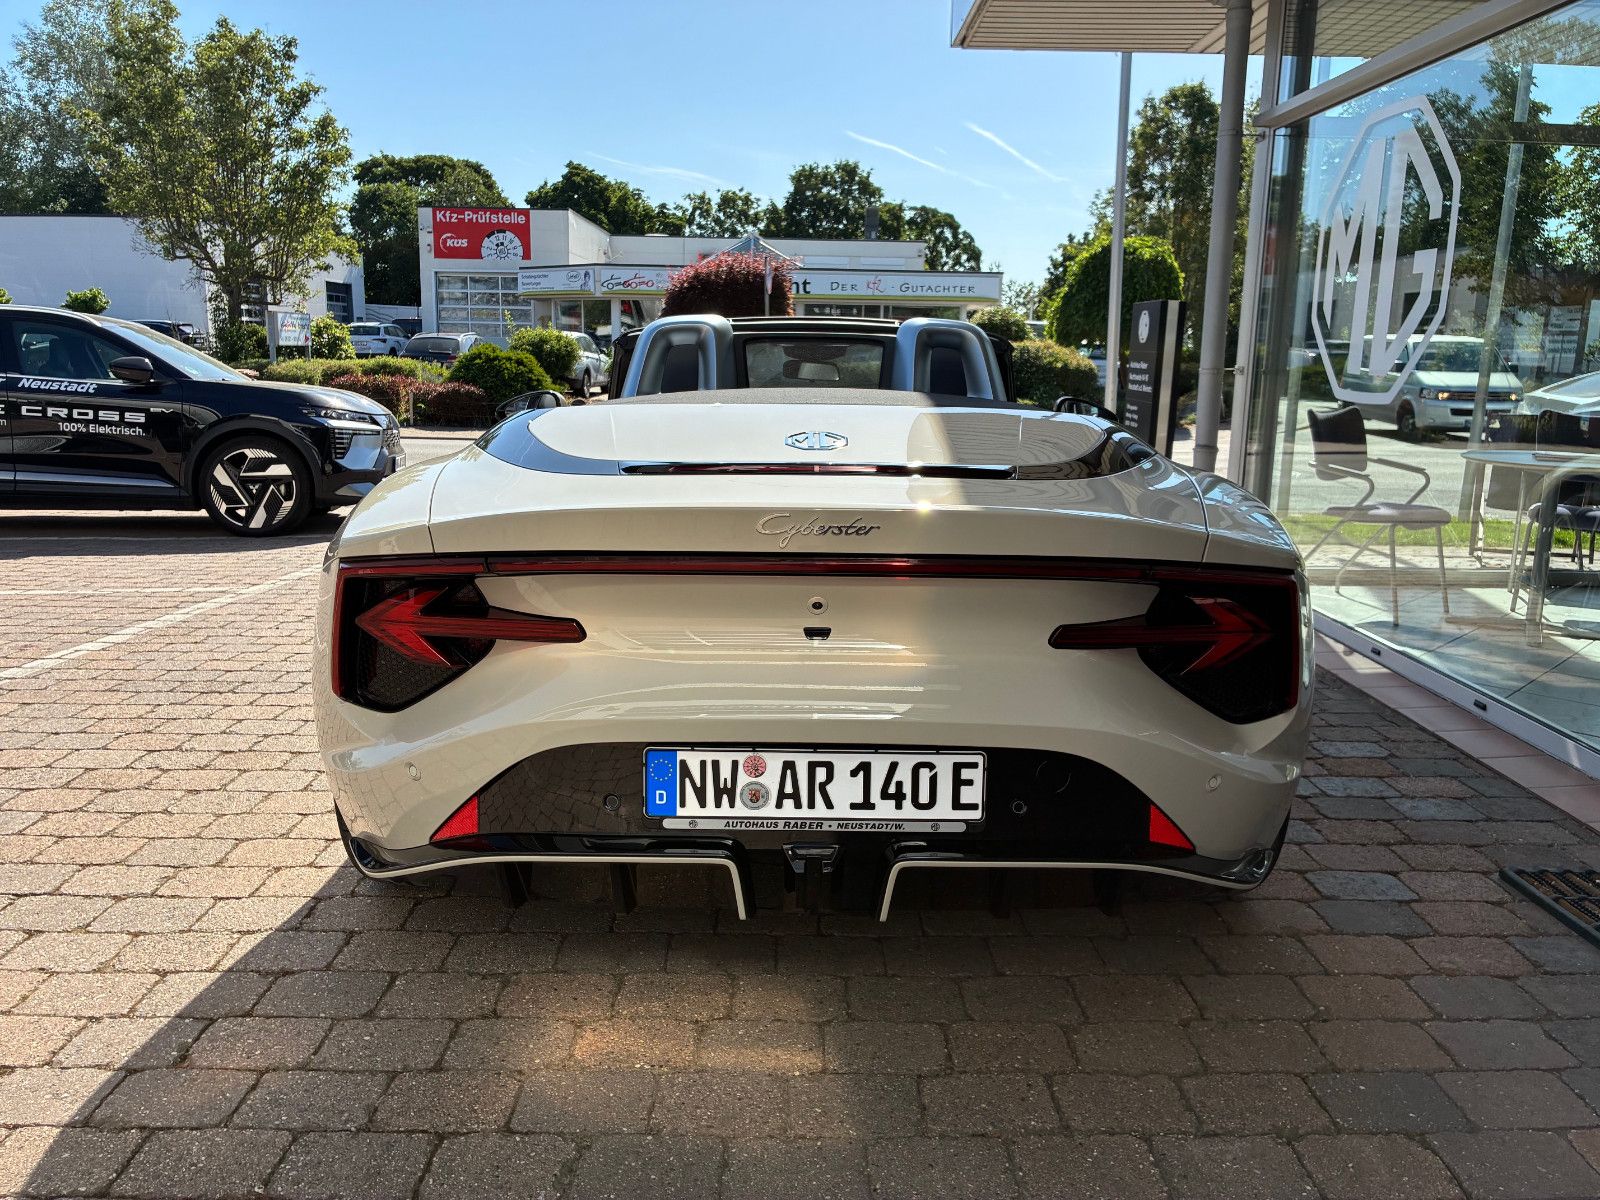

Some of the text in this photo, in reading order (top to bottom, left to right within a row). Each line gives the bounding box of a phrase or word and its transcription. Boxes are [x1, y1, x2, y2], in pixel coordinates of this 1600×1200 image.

[436, 211, 527, 225] Kfz-Prüfstelle
[1322, 127, 1444, 378] MG
[790, 278, 811, 294] nt
[899, 282, 976, 294] GUTACHTER
[17, 377, 98, 394] Neustadt
[20, 405, 146, 423] CROSS
[57, 422, 146, 436] 100% Elektrisch.
[755, 513, 881, 549] Cyberster
[679, 758, 739, 809] NW
[774, 760, 835, 810] AR
[655, 790, 667, 805] D
[723, 820, 780, 830] AUTOHAUS
[782, 820, 824, 830] RABER
[836, 822, 906, 831] NEUSTADT/W.
